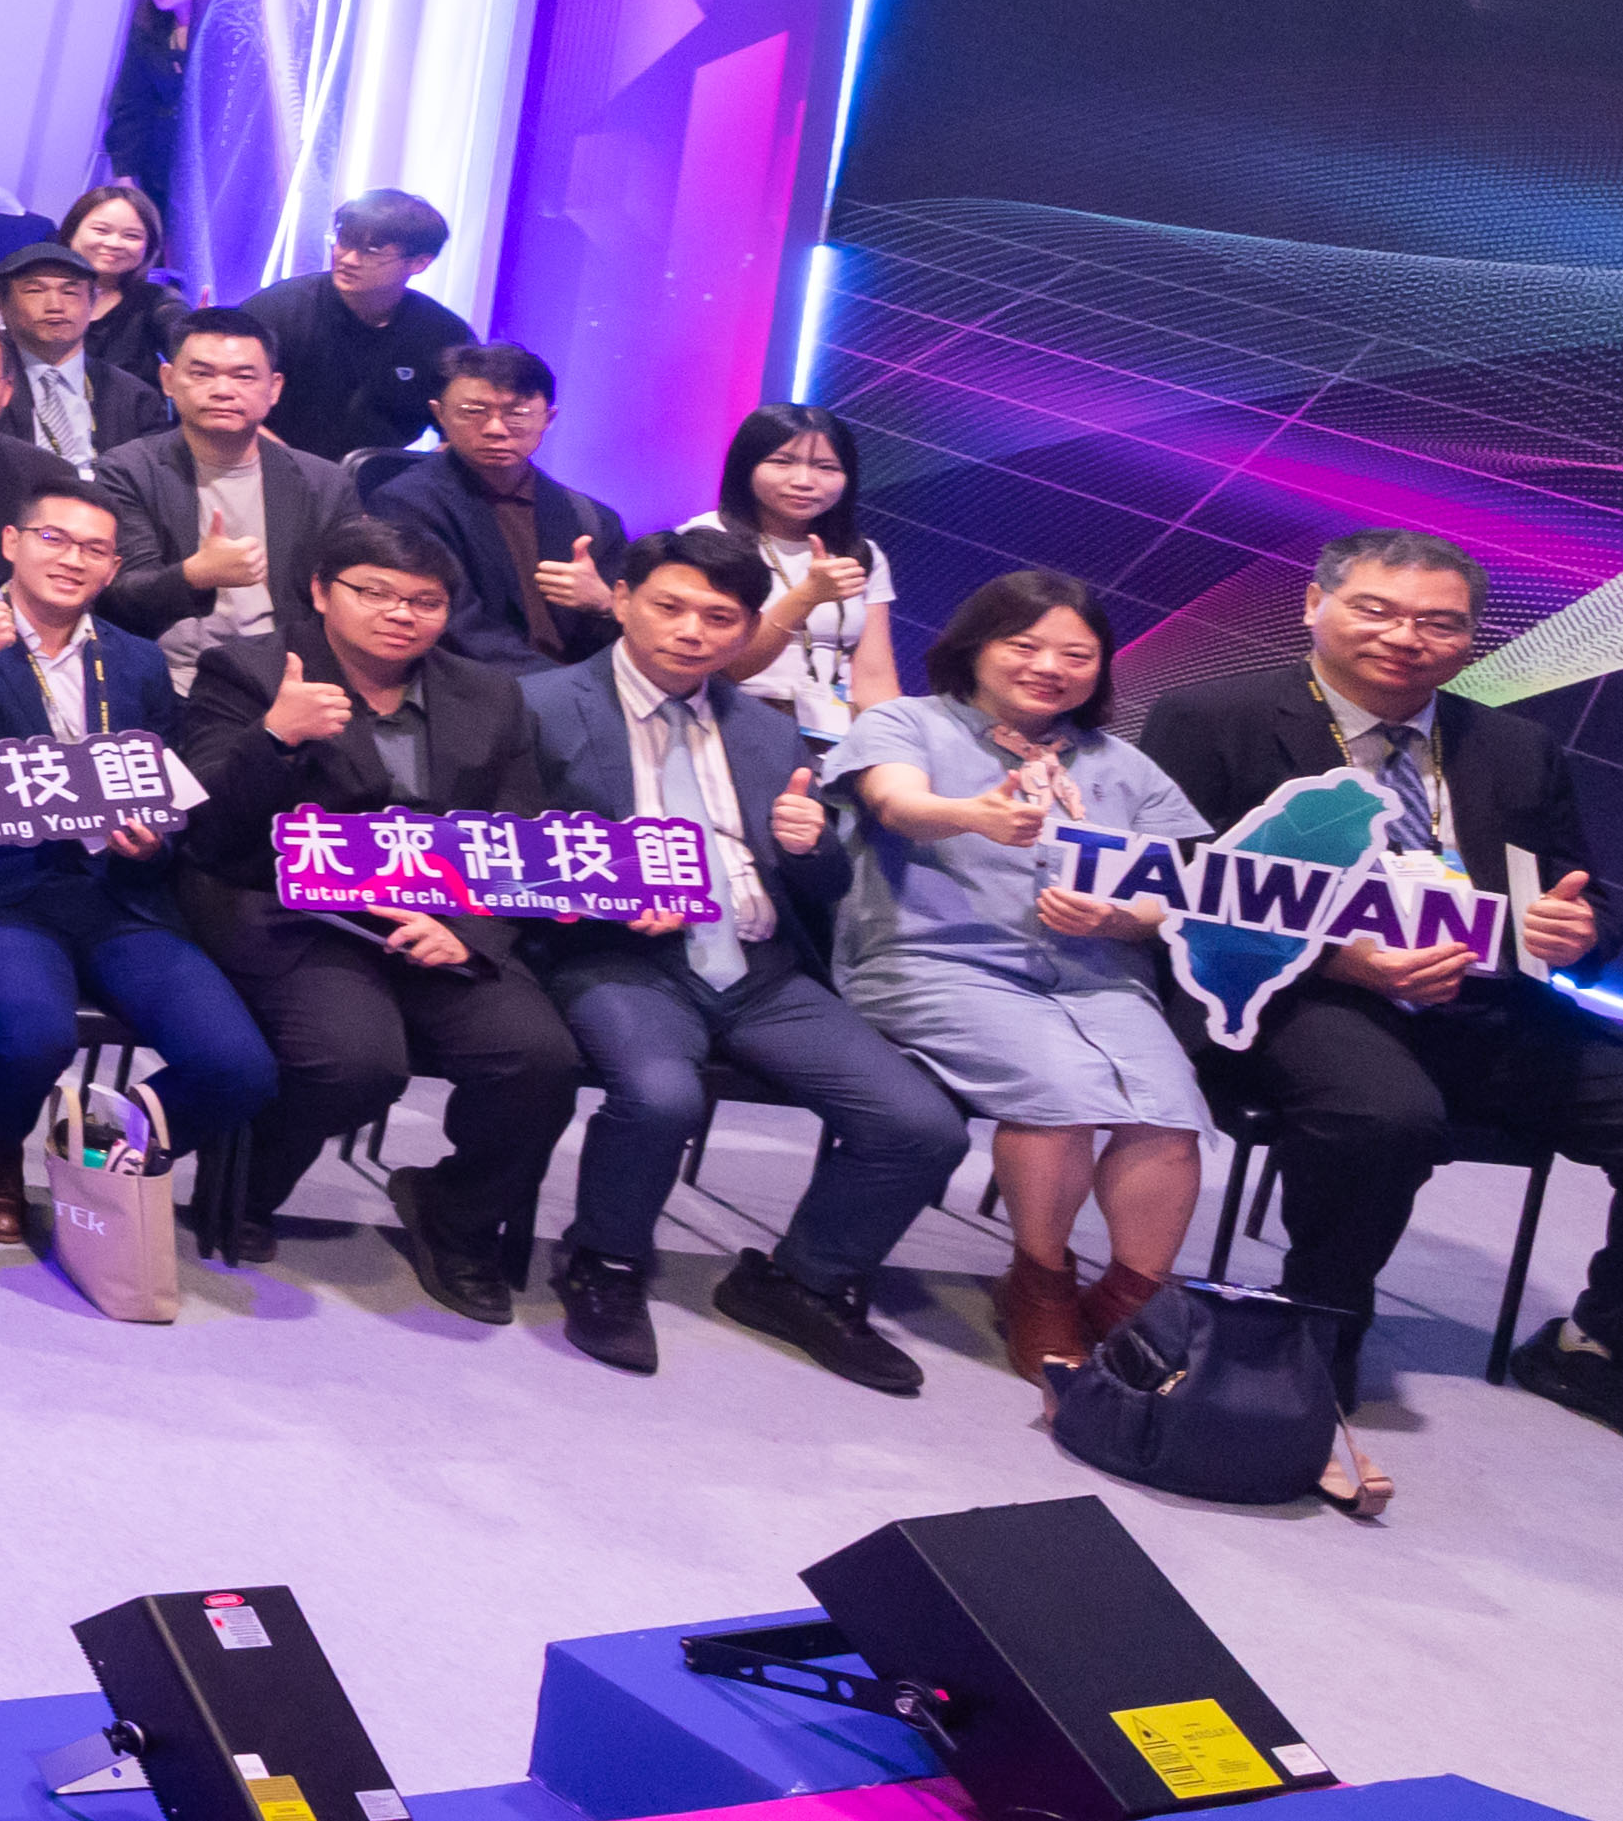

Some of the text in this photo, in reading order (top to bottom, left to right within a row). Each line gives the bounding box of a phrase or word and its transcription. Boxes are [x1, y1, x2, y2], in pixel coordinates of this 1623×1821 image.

[43, 810, 106, 832] Your
[115, 804, 179, 828] Life.
[284, 813, 706, 886] 未來科技館
[289, 880, 715, 918] Future Tech, Leading Your Life.
[1051, 827, 1500, 966] TAIWAN
